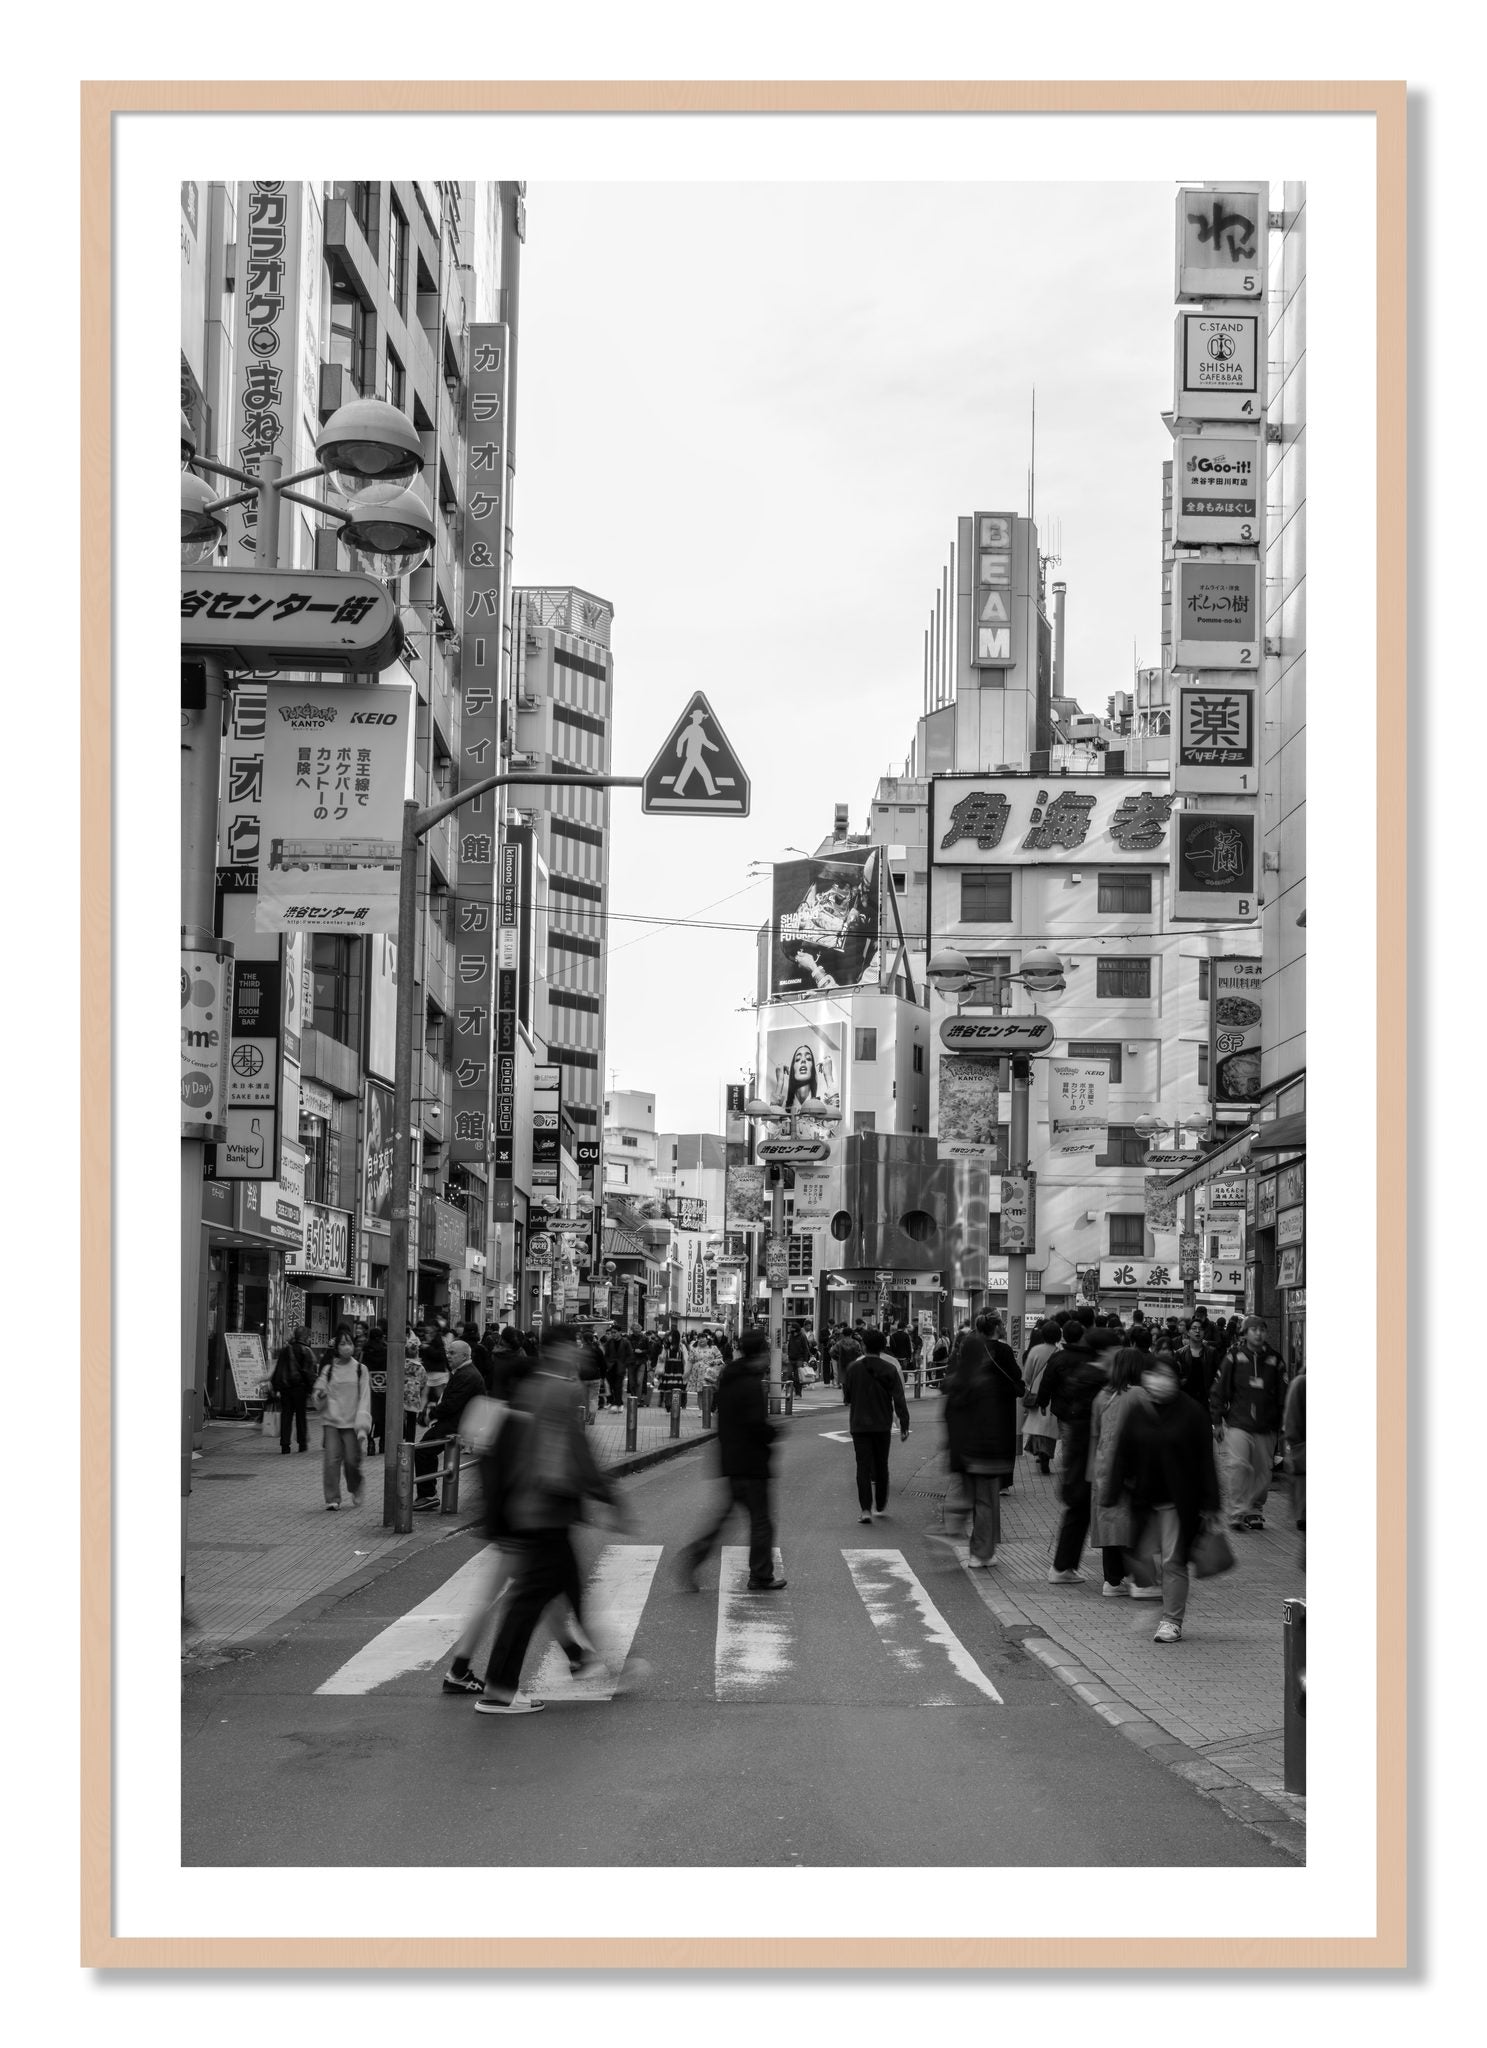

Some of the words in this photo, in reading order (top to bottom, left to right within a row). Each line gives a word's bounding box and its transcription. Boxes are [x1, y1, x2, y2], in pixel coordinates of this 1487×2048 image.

[246, 194, 287, 327] カラオケ
[1243, 276, 1254, 291] 5
[1200, 323, 1244, 332] C.STAND
[1200, 363, 1243, 373] SHISHA
[1200, 373, 1243, 381] CAFE&BAR
[1241, 400, 1254, 415] 4
[1198, 458, 1251, 473] Goo-it!
[1191, 477, 1248, 486] 渋谷宇田川町店
[1186, 502, 1252, 514] 全身もみほぐし
[1241, 524, 1252, 540] 3
[979, 518, 1011, 658] BEAM
[1240, 649, 1251, 664] 2
[291, 720, 325, 728] KANTO
[350, 712, 398, 725] KEIO
[1190, 696, 1240, 746] 薬
[1184, 749, 1245, 763] マツモトキヨシ
[296, 747, 311, 789] 冒険へ
[314, 747, 331, 819] カントーの
[334, 747, 351, 820] ポケパーク
[355, 748, 372, 806] 京王線で
[1239, 774, 1248, 789] 1
[941, 790, 1174, 850] 角海老
[1184, 829, 1244, 876] 一蘭
[505, 849, 513, 883] kimono
[283, 906, 370, 919] 渋谷センター街
[504, 888, 513, 922] hearts
[1238, 900, 1250, 915] B
[1219, 977, 1261, 989] 四川料理
[947, 1025, 1048, 1038] 渋谷センター街
[1216, 1034, 1244, 1052] 6F
[192, 1081, 212, 1095] Day!
[227, 1145, 259, 1155] Whisky
[580, 1148, 598, 1158] GU
[760, 1145, 822, 1154] 渋谷センター街
[226, 1154, 246, 1162] Bank
[1113, 1264, 1172, 1286] 兆楽
